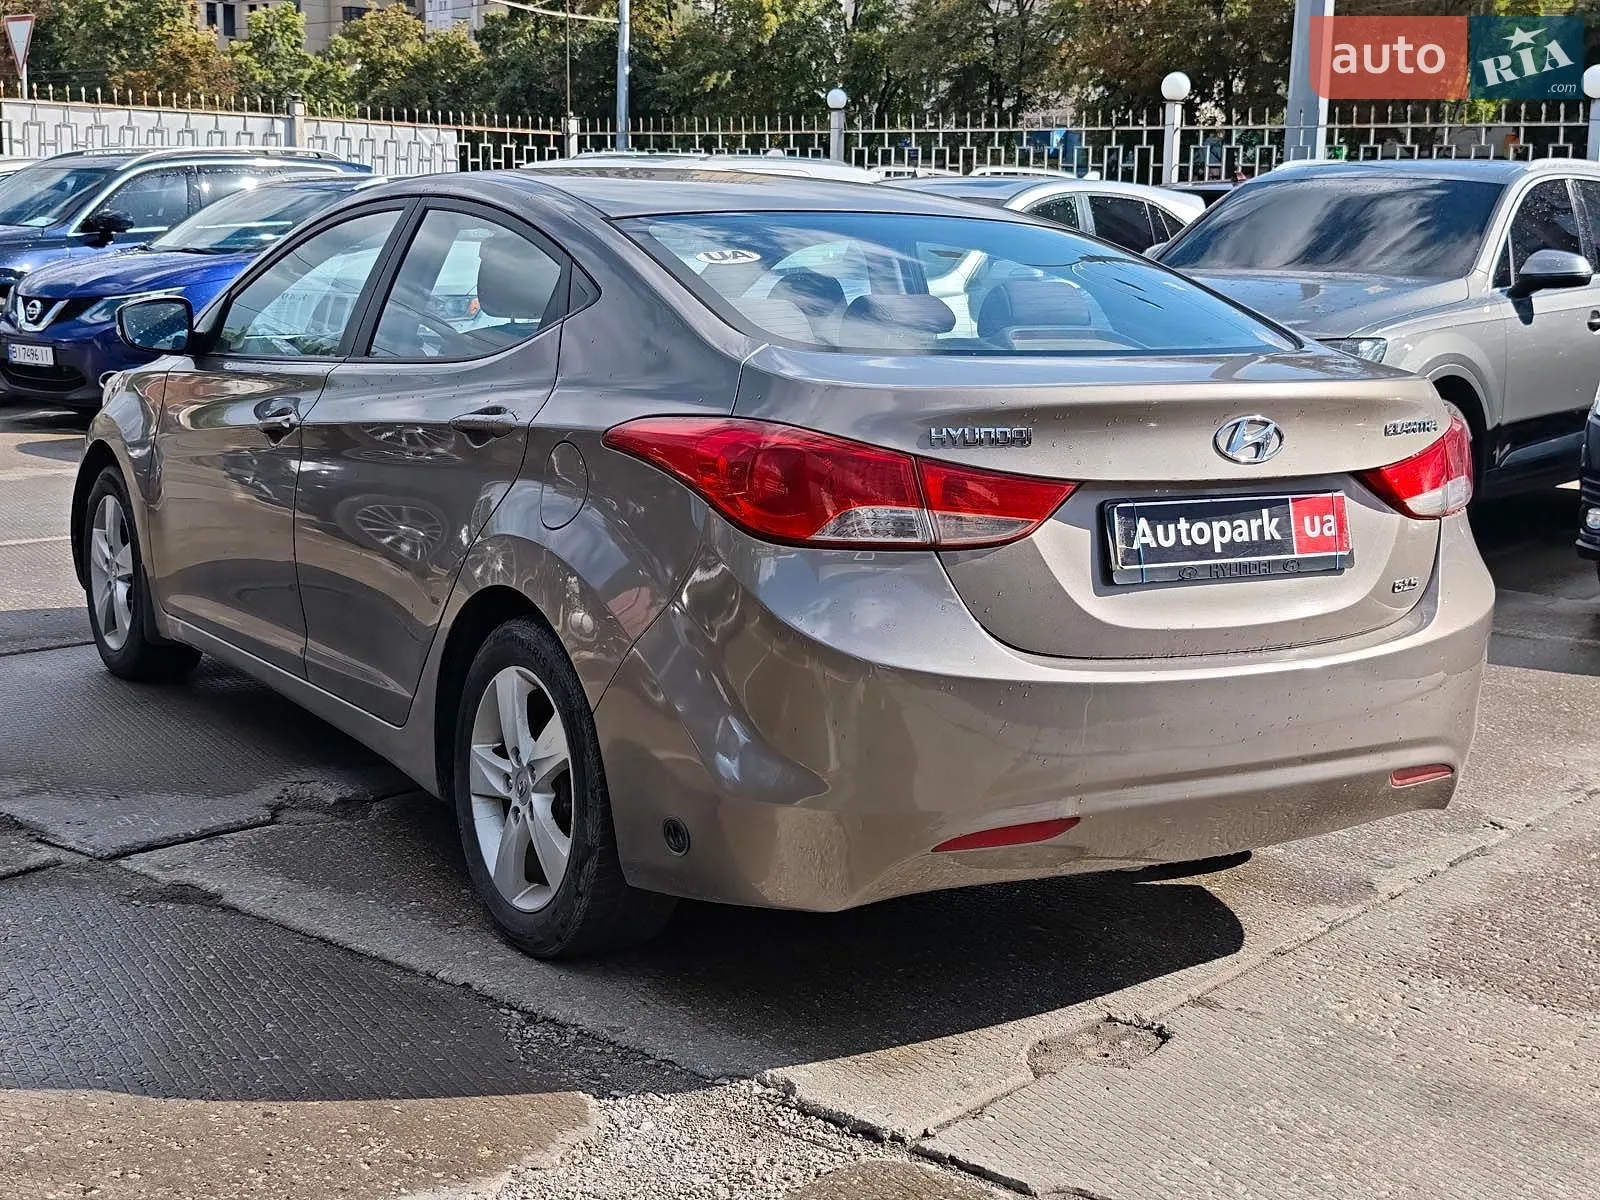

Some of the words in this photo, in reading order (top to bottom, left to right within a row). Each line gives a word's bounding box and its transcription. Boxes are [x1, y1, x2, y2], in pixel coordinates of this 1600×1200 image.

[703, 250, 754, 261] UA
[929, 427, 1033, 447] HYUNDAI
[1132, 509, 1282, 552] Autopark
[1303, 514, 1337, 538] ua
[1209, 559, 1272, 579] HYUNDAI
